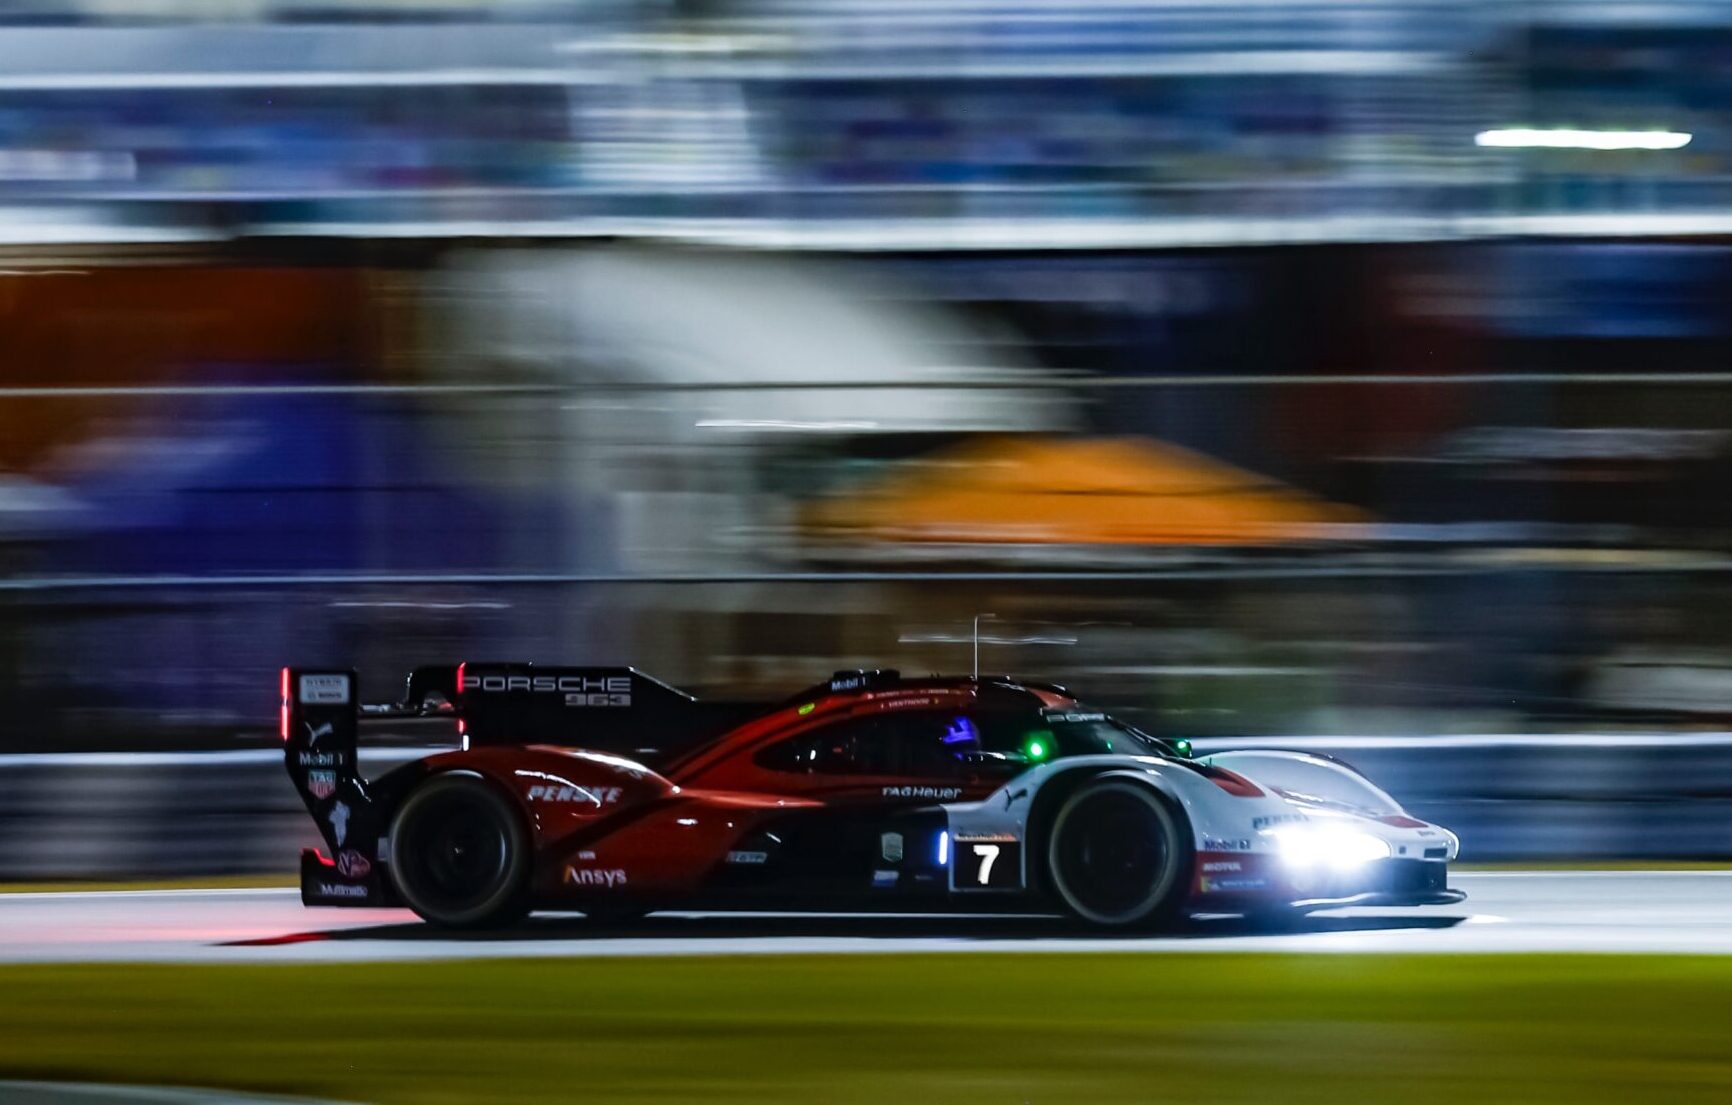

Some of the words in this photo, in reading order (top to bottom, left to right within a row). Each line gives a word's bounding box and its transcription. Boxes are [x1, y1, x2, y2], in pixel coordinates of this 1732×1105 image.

[463, 676, 631, 691] PORSCHE
[832, 679, 858, 691] Mobil
[565, 693, 631, 706] 963
[300, 752, 333, 765] Mobil
[527, 785, 623, 802] PENSKE
[973, 844, 1000, 885] 7
[564, 865, 627, 888] Ansys
